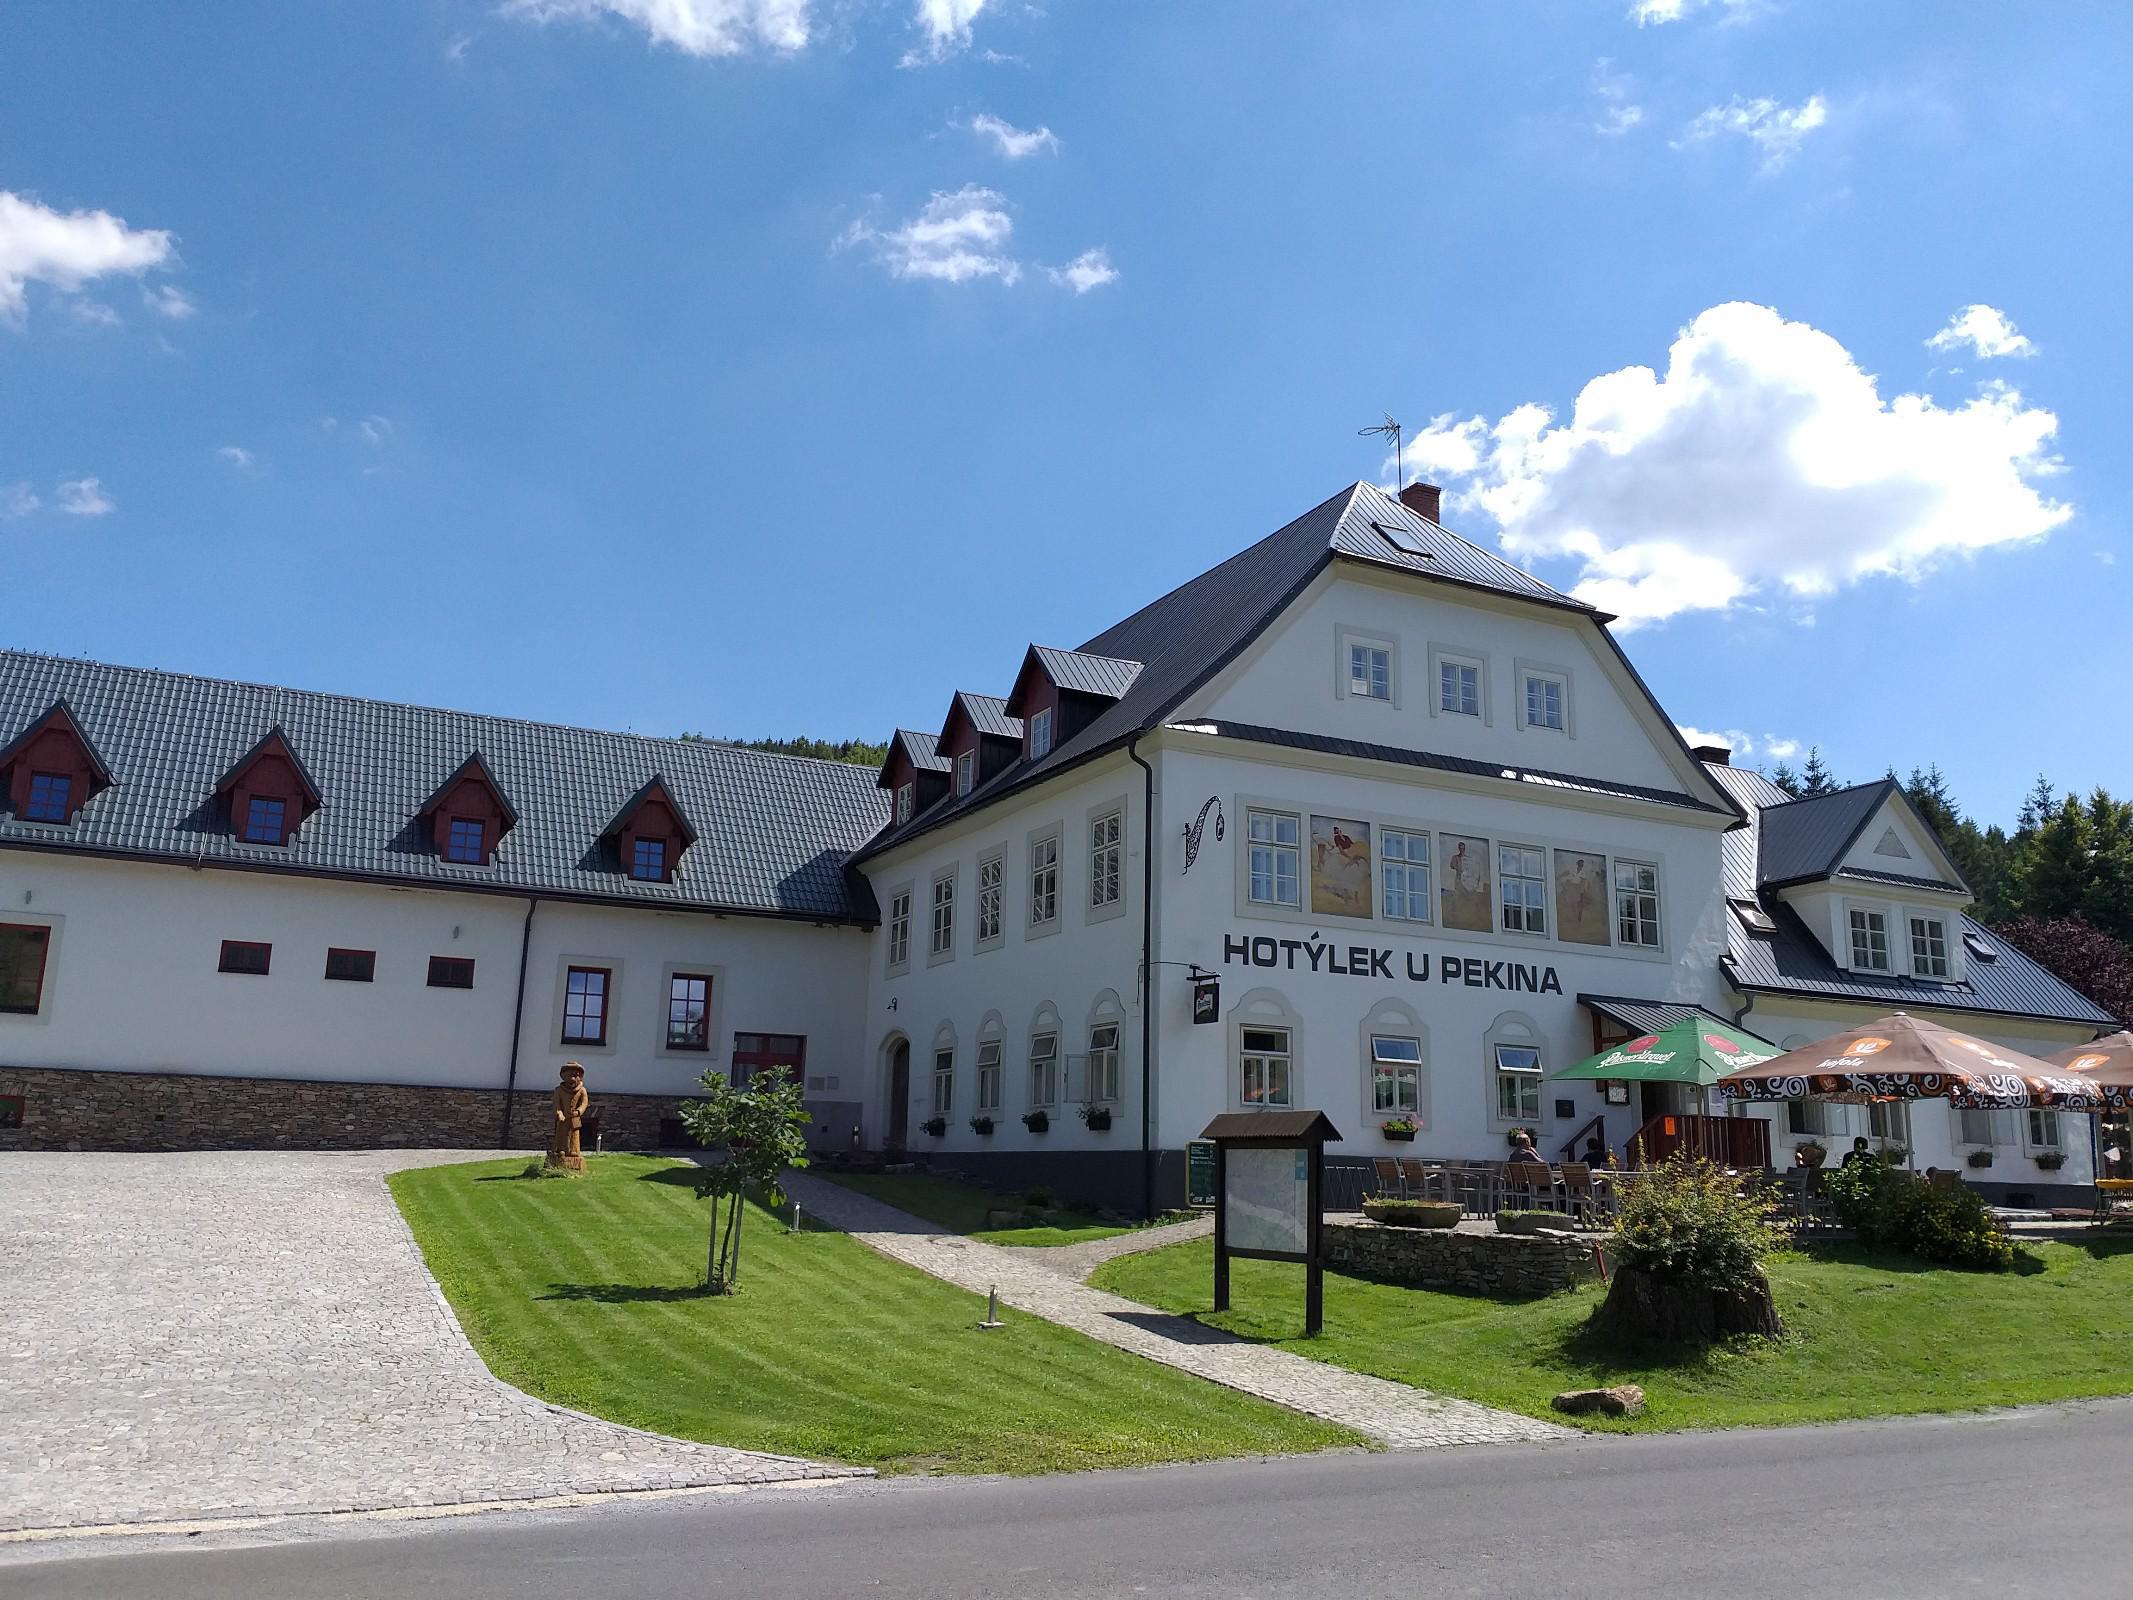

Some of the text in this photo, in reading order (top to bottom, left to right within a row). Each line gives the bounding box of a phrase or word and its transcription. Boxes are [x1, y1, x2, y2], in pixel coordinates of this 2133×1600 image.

[1224, 931, 1563, 996] HOTÝLEK U PEKINA
